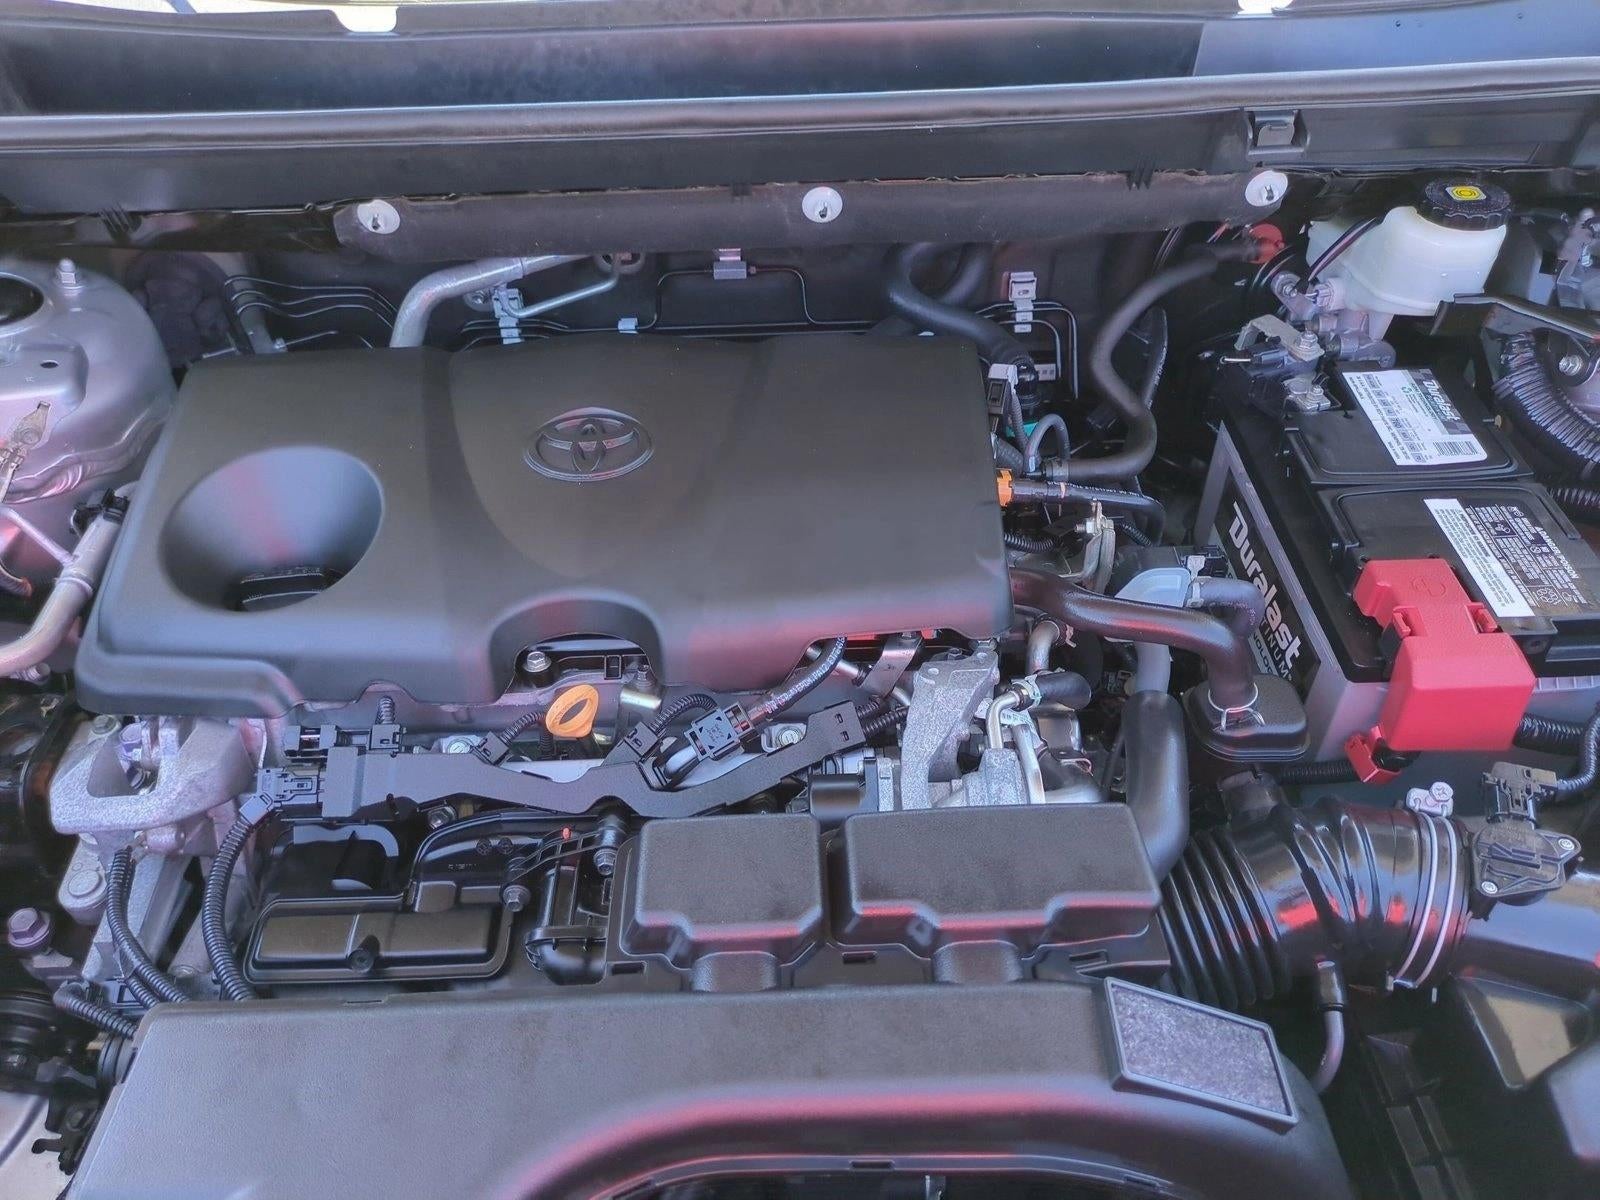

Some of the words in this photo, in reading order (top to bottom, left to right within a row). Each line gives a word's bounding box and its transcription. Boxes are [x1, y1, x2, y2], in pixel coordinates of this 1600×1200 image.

[1423, 380, 1460, 421] Duralast
[1229, 501, 1301, 669] Duralast
[1260, 617, 1290, 678] TINUM
